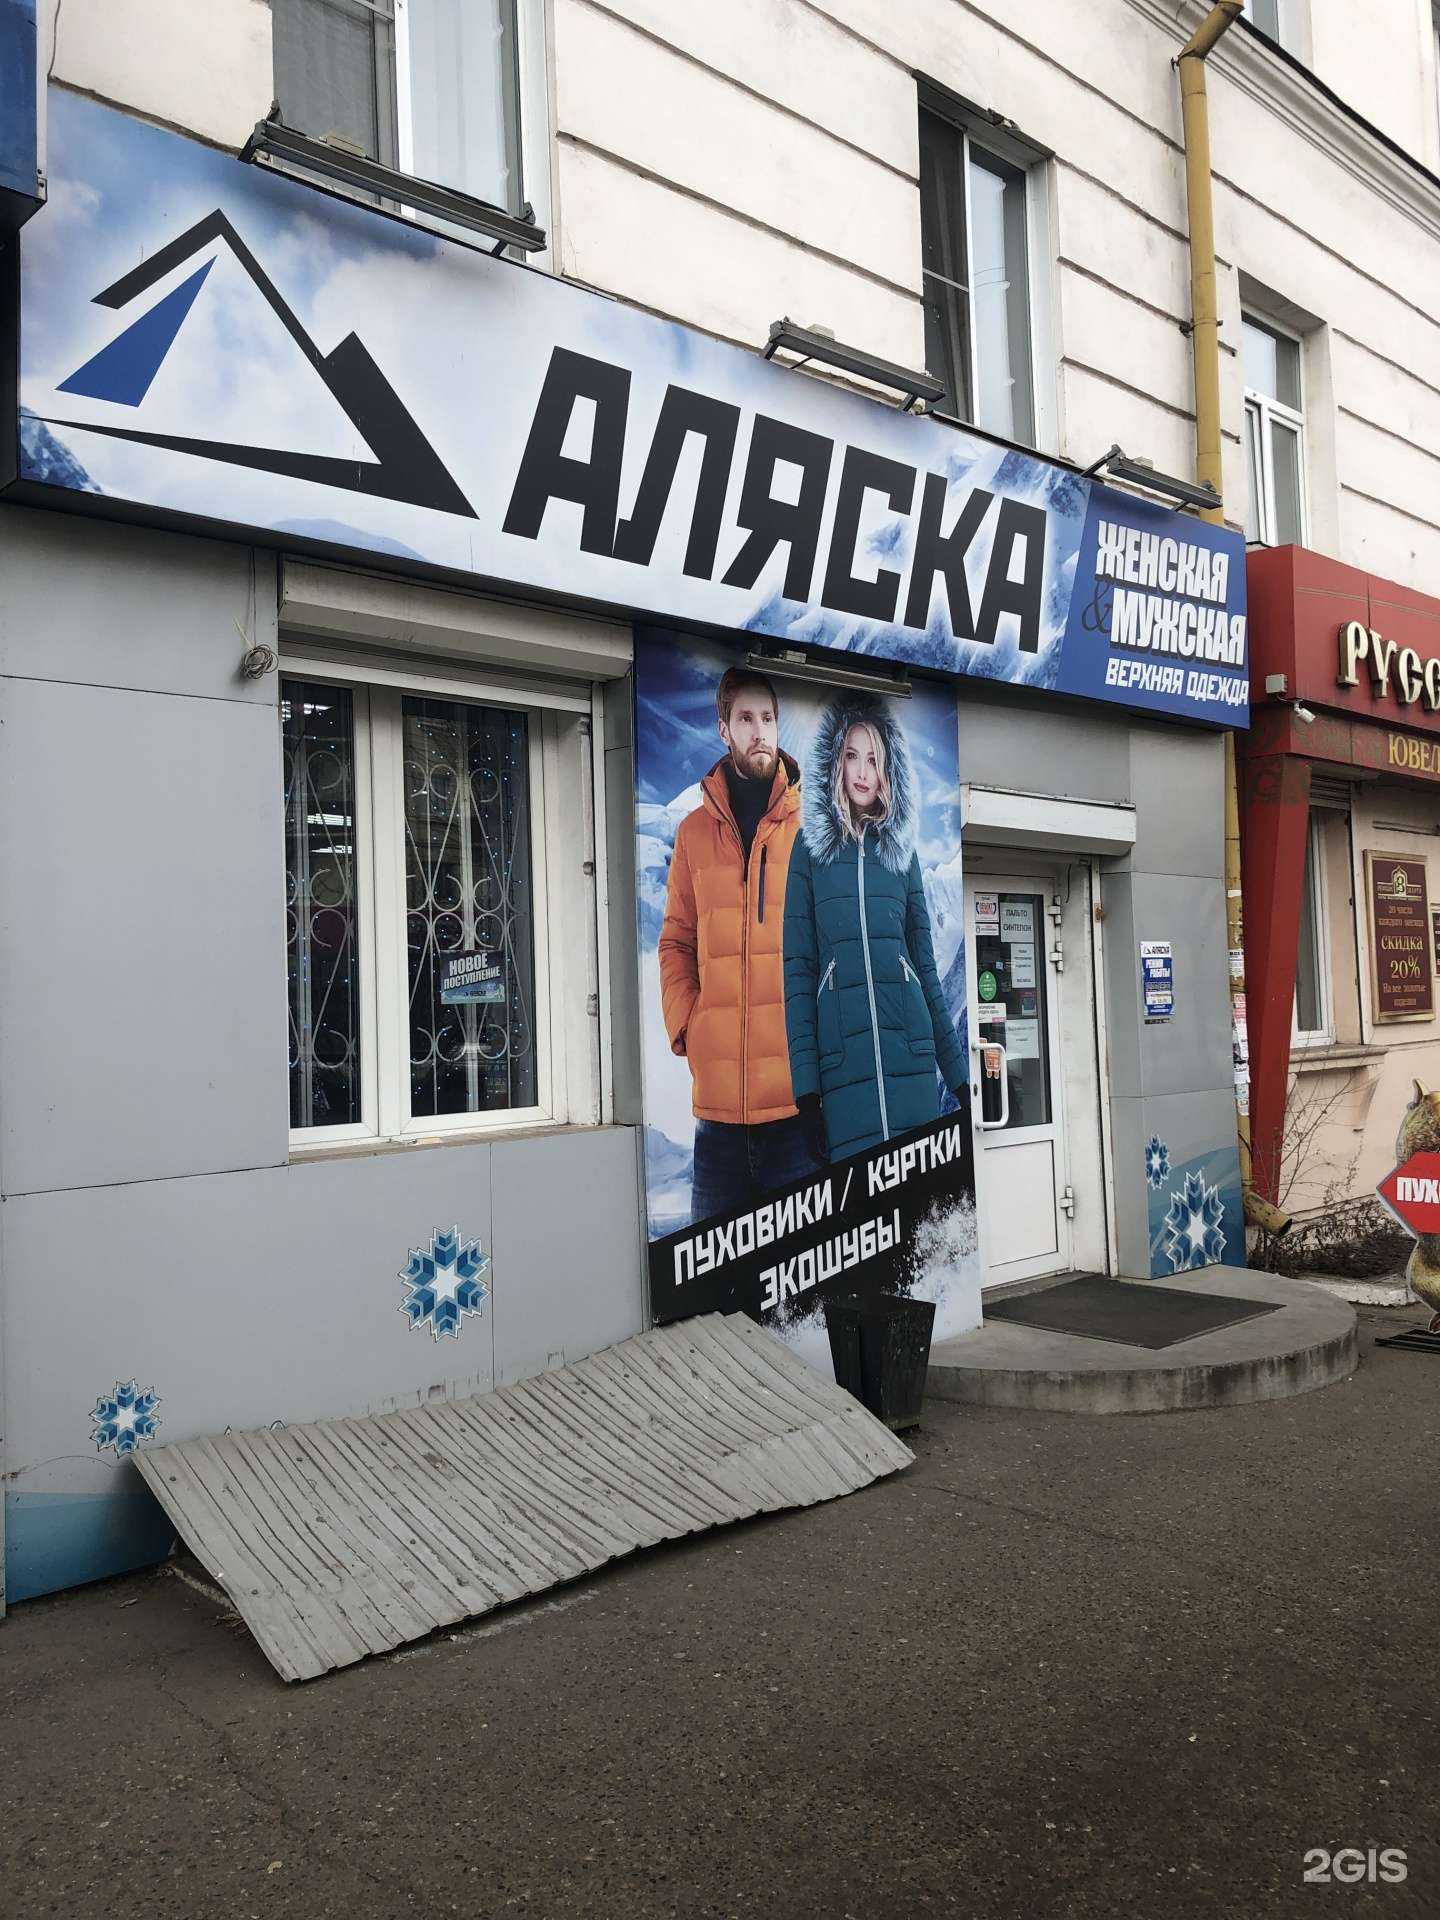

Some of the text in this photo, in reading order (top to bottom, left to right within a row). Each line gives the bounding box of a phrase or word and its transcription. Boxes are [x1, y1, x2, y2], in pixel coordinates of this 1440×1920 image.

[502, 346, 1046, 653] АЛЯСКА
[1095, 520, 1229, 604] ЖЕНСКАЯ
[1110, 588, 1247, 665] МУЖСКАЯ
[1105, 658, 1250, 706] ВЕРХНЯЯ ОДЕЖДА
[443, 966, 501, 990] ПОСТУПЛЕНИЕ
[449, 952, 488, 977] НОВОЕ
[1390, 954, 1421, 979] 20%
[673, 1179, 832, 1286] ПУХОВИКИ
[868, 1124, 961, 1197] КУРТКИ
[1397, 1177, 1440, 1203] ПУХ
[759, 1208, 900, 1311] ЭКОШУБЫ
